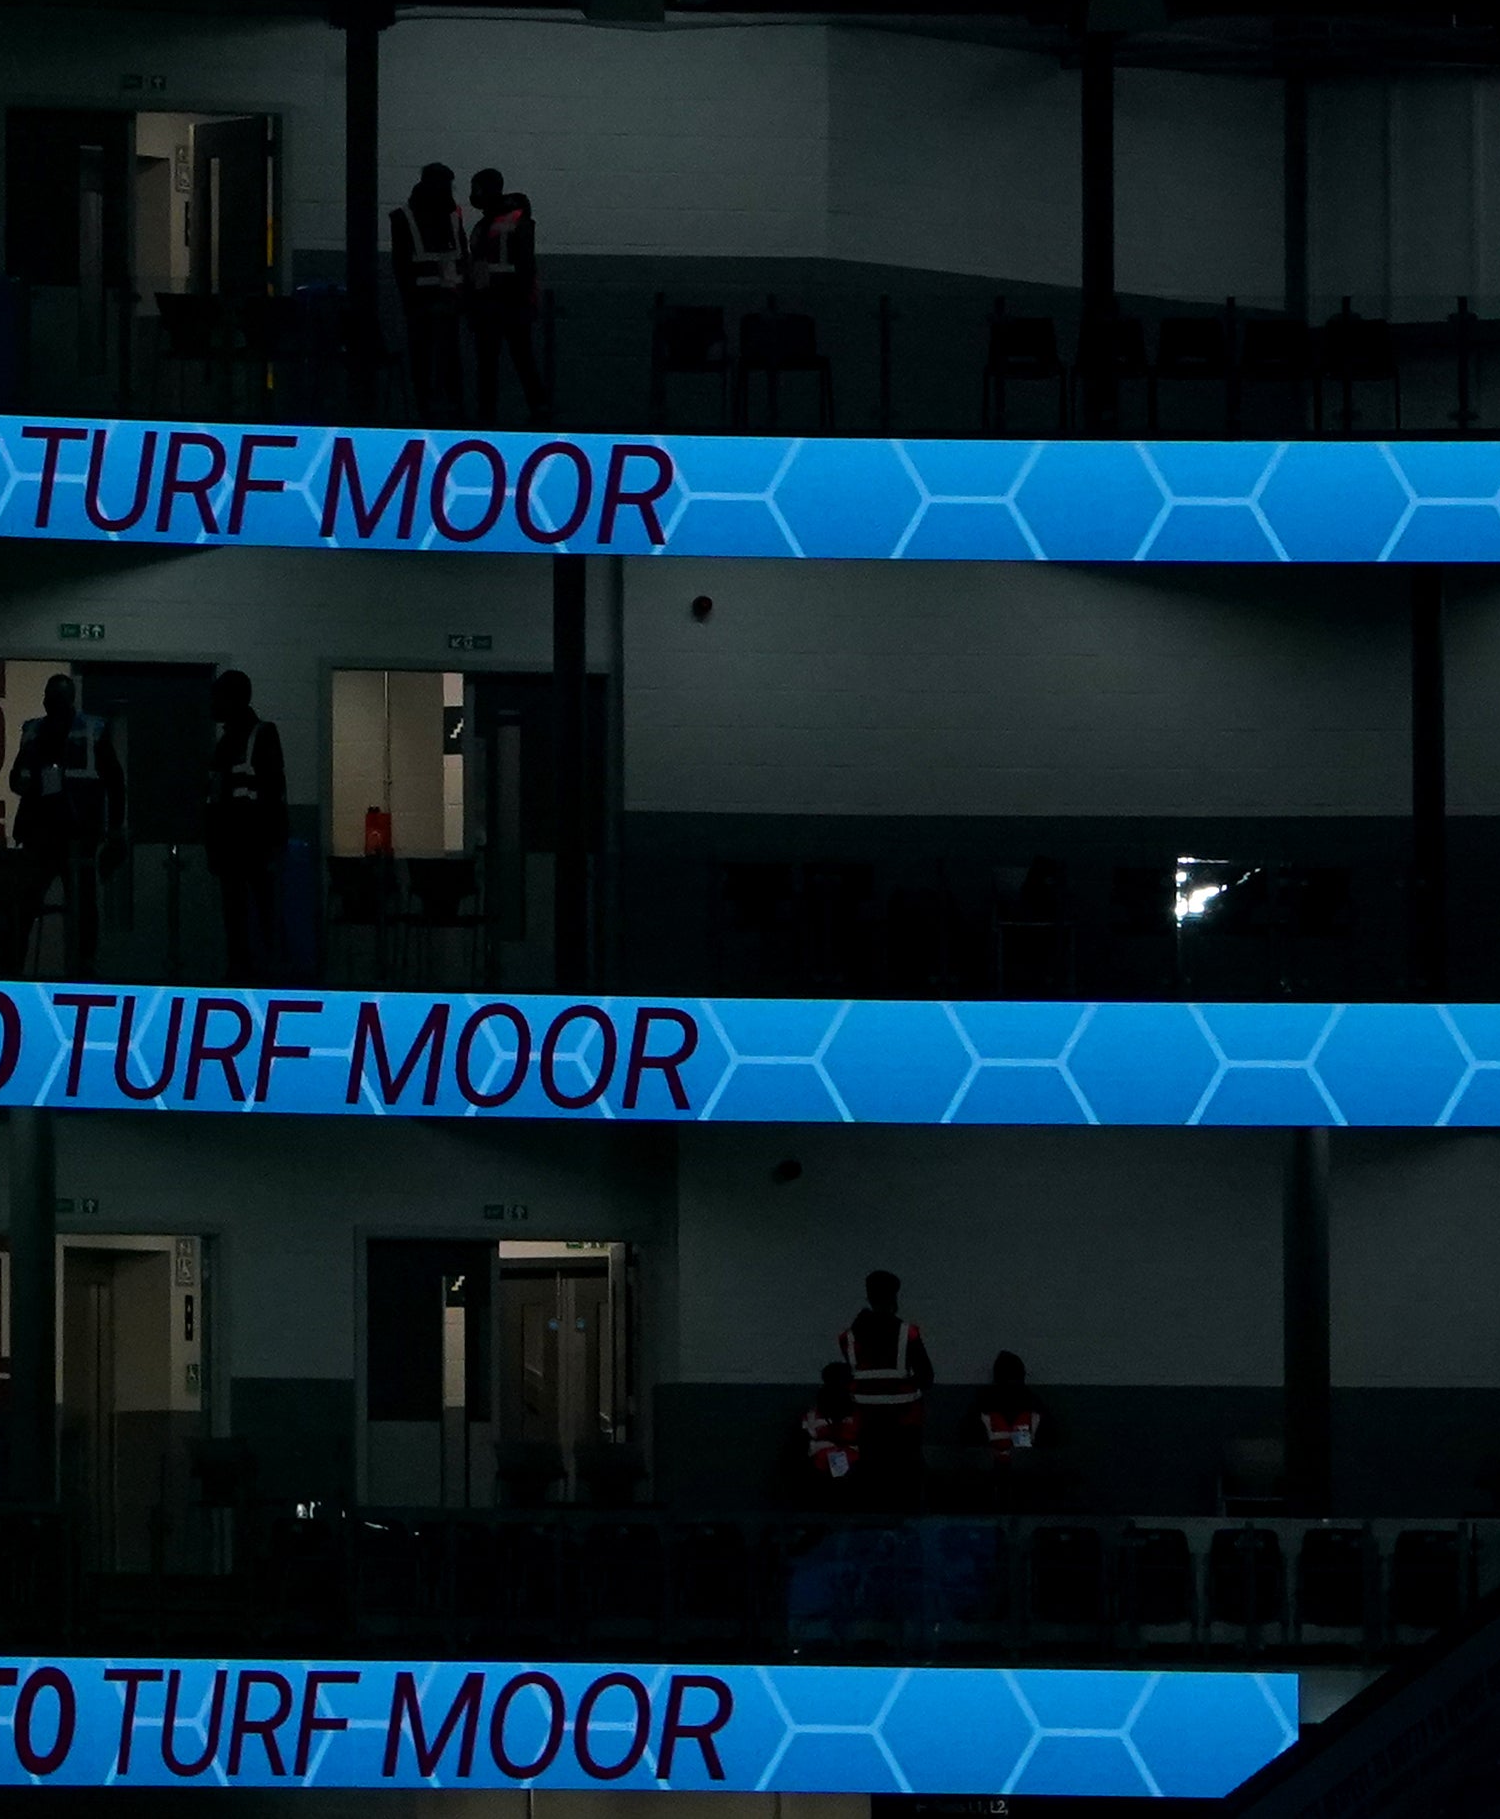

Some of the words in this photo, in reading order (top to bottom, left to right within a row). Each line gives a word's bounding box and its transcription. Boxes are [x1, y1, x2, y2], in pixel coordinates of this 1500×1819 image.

[21, 426, 298, 535] TURF
[319, 437, 675, 546] MOOR
[52, 993, 323, 1103] TURF
[345, 1002, 699, 1110] MOOR
[103, 1668, 361, 1778] TURF
[382, 1672, 734, 1781] MOOR
